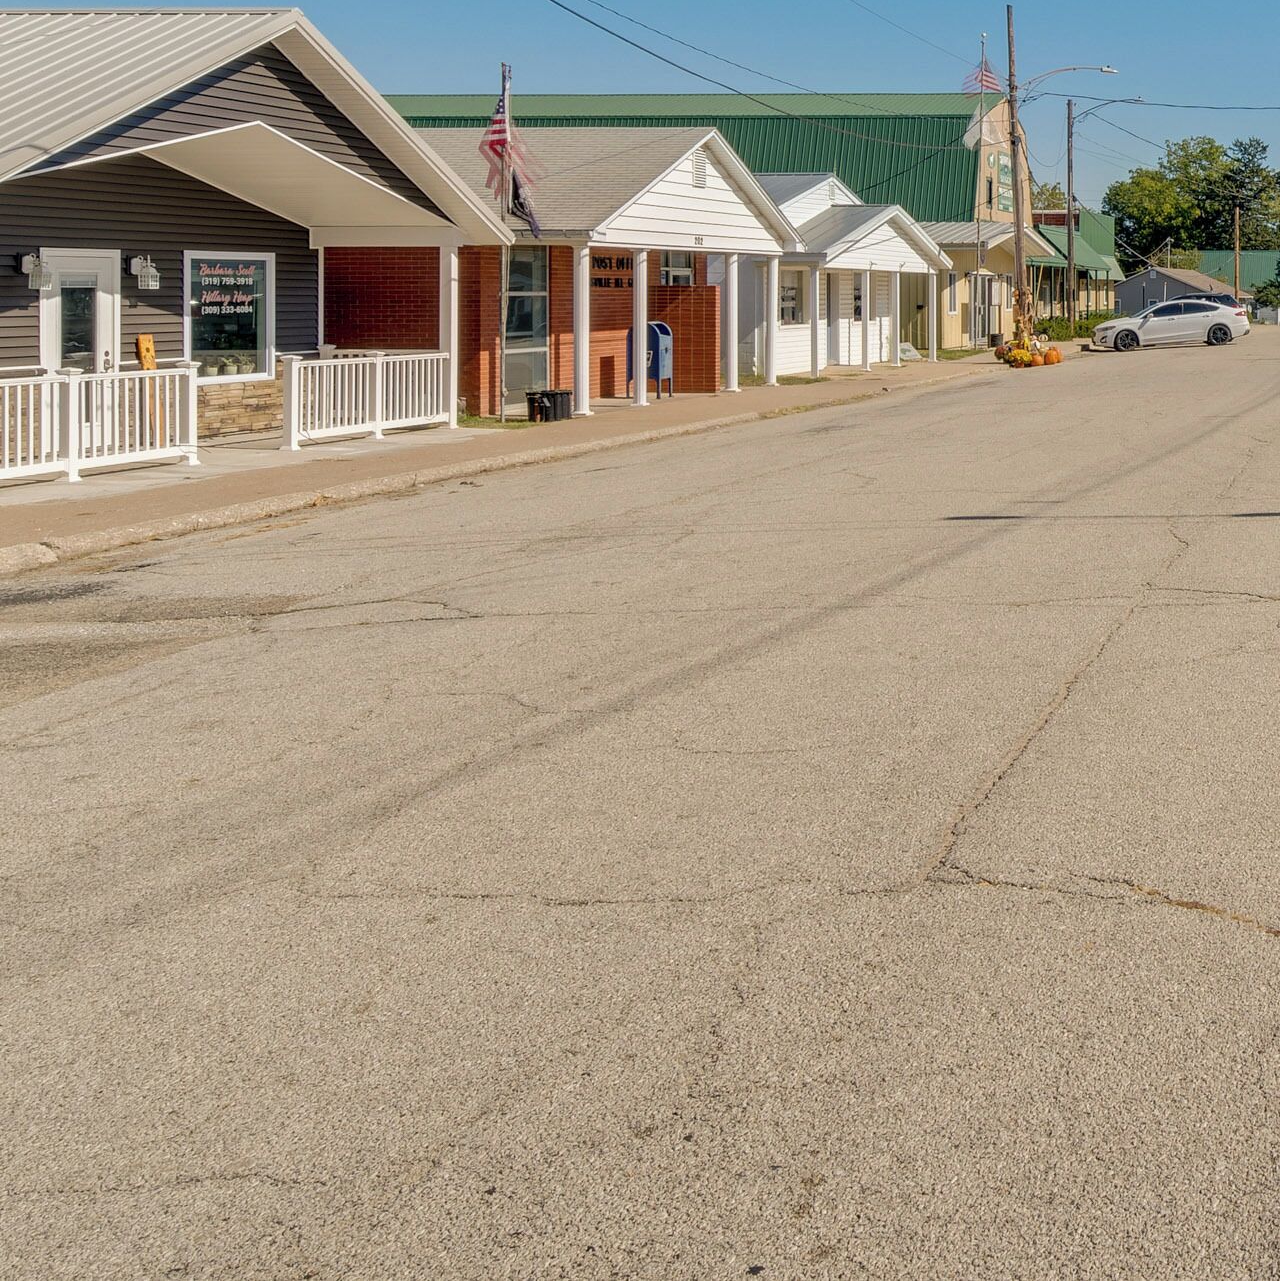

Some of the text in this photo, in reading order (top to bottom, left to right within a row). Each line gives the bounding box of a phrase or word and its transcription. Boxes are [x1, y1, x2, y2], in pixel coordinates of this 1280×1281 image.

[694, 237, 704, 246] 202
[592, 257, 612, 270] POST
[200, 263, 234, 275] Barbara
[201, 277, 220, 286] (319)
[201, 306, 220, 315] (309)
